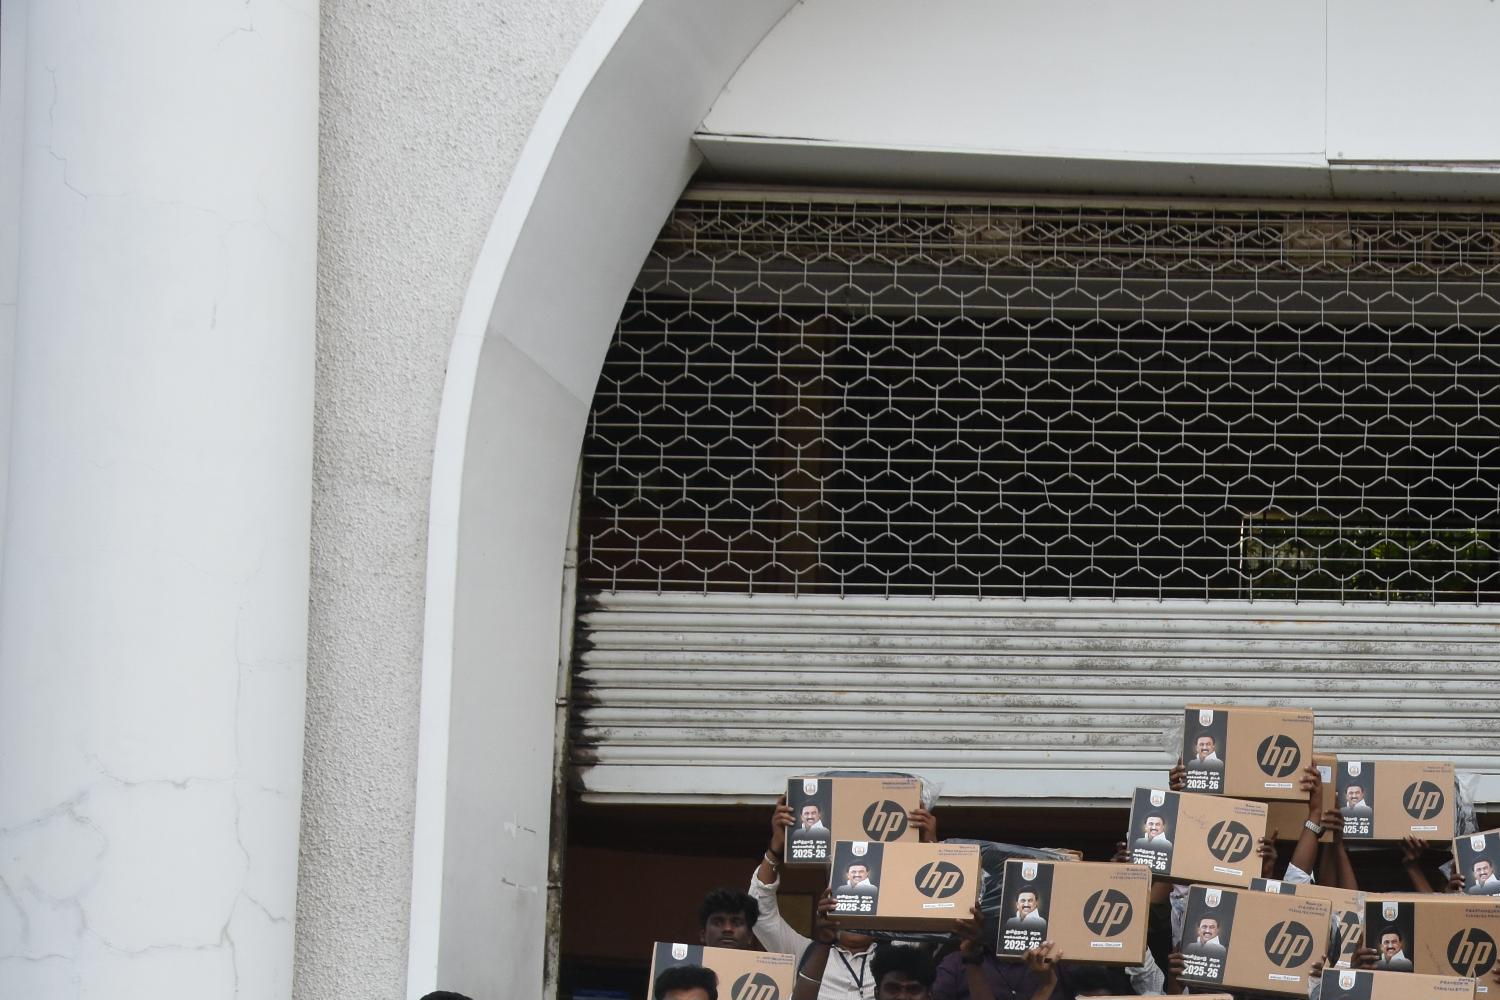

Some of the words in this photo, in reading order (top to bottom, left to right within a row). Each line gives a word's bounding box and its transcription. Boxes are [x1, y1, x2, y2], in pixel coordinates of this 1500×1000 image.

[1261, 734, 1298, 778] hp
[1187, 778, 1219, 791] 2025-26
[1407, 780, 1441, 820] hp
[867, 800, 904, 843] hp
[1211, 820, 1250, 863] hp
[1343, 824, 1369, 835] 025-26
[792, 848, 826, 859] 2025-26
[919, 861, 961, 899] hp
[834, 902, 872, 912] 2025-26
[1088, 889, 1129, 937] hp
[1268, 920, 1311, 968] hp
[1451, 928, 1494, 977] hp
[1182, 963, 1219, 979] 2025-26
